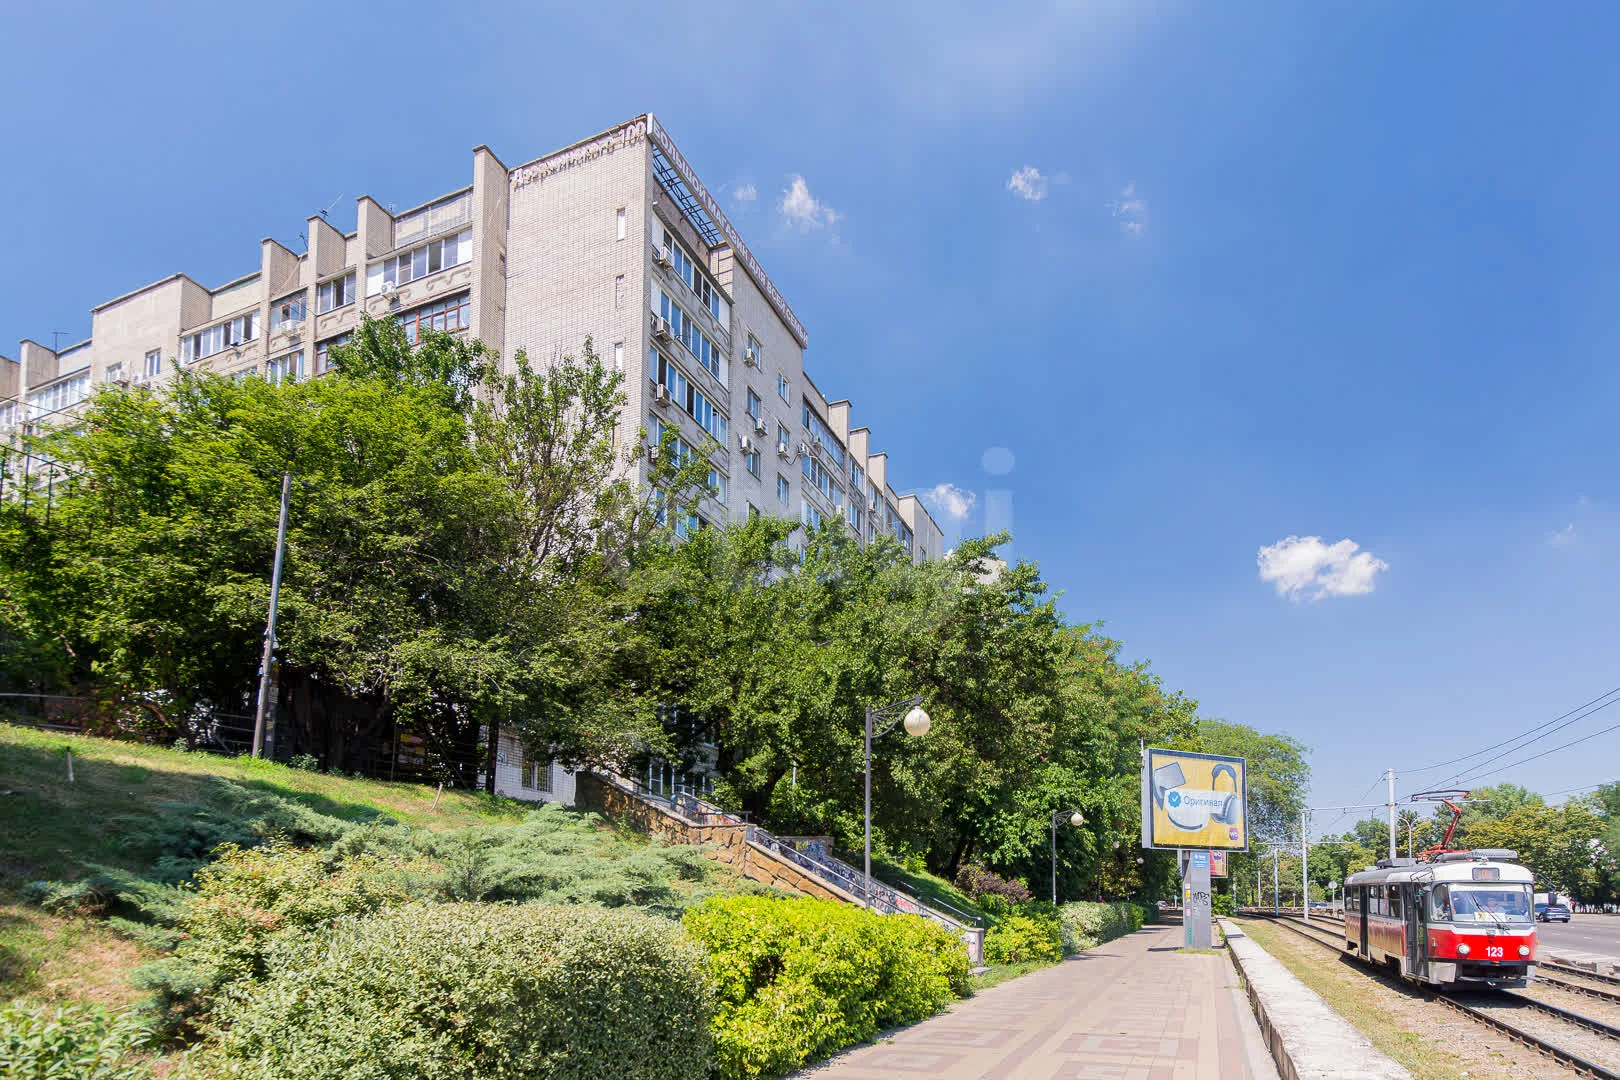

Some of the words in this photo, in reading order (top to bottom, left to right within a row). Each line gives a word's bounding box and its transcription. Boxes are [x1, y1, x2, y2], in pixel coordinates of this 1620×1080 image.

[653, 120, 707, 204] БОЛЬШОЙ
[706, 199, 749, 261] МАГАЗИН
[749, 255, 766, 286] ДЛЯ
[766, 280, 786, 313] ВСЕЙ
[785, 308, 808, 346] СЕМЬИ
[1183, 795, 1223, 808] Оригинал
[1485, 946, 1504, 958] 123
